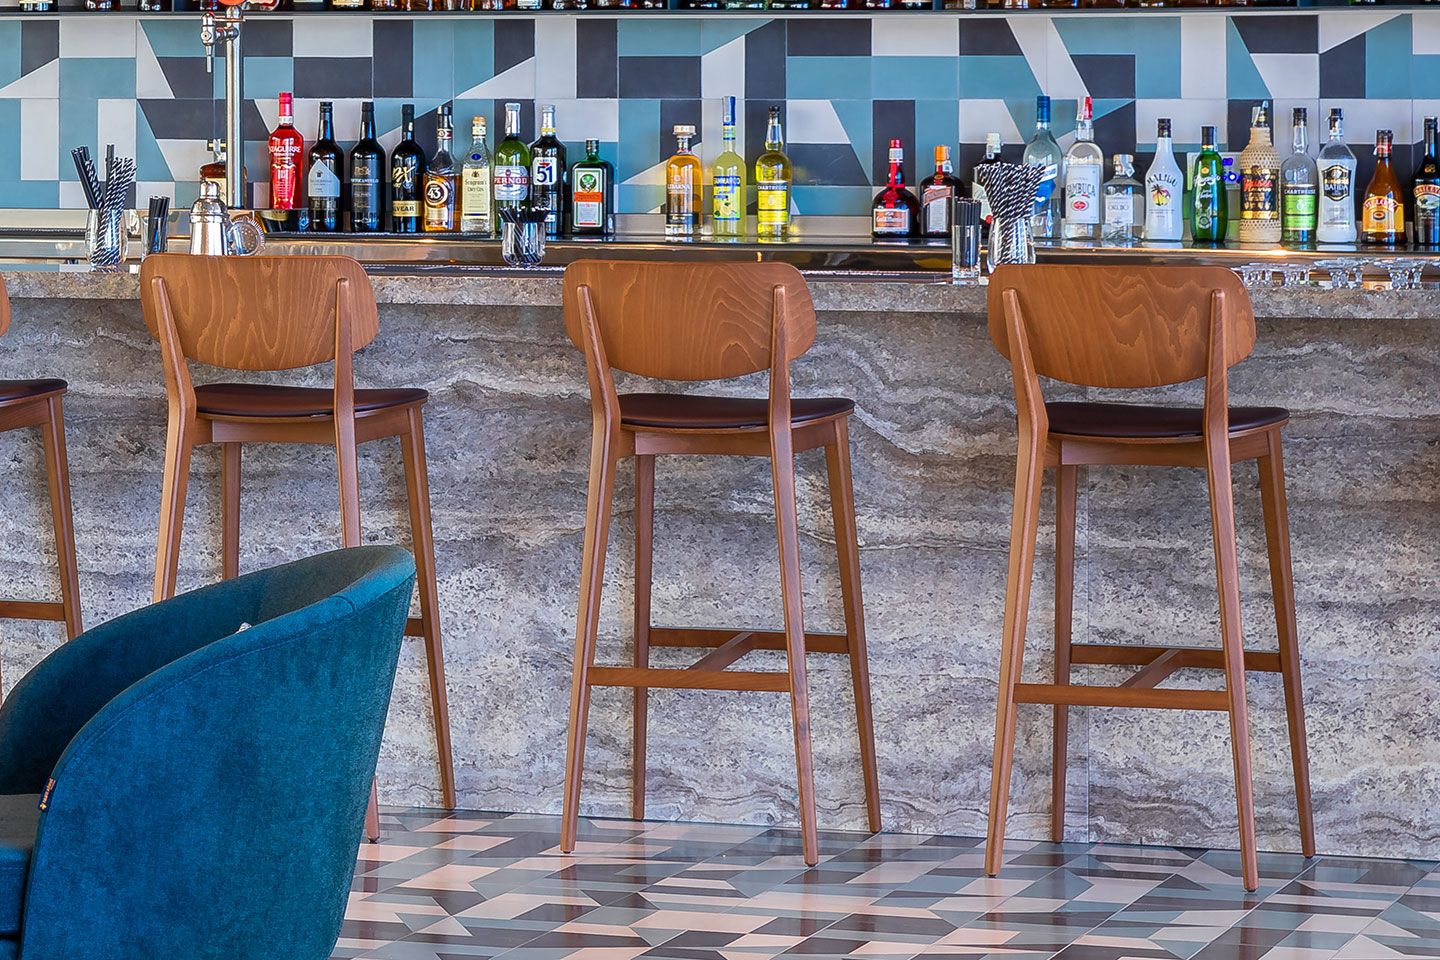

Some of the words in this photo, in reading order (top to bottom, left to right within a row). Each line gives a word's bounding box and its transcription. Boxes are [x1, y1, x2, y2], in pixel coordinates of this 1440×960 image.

[536, 165, 553, 183] 51
[1147, 173, 1178, 187] MALIBU
[494, 177, 528, 185] PERNOD
[427, 187, 442, 199] 43
